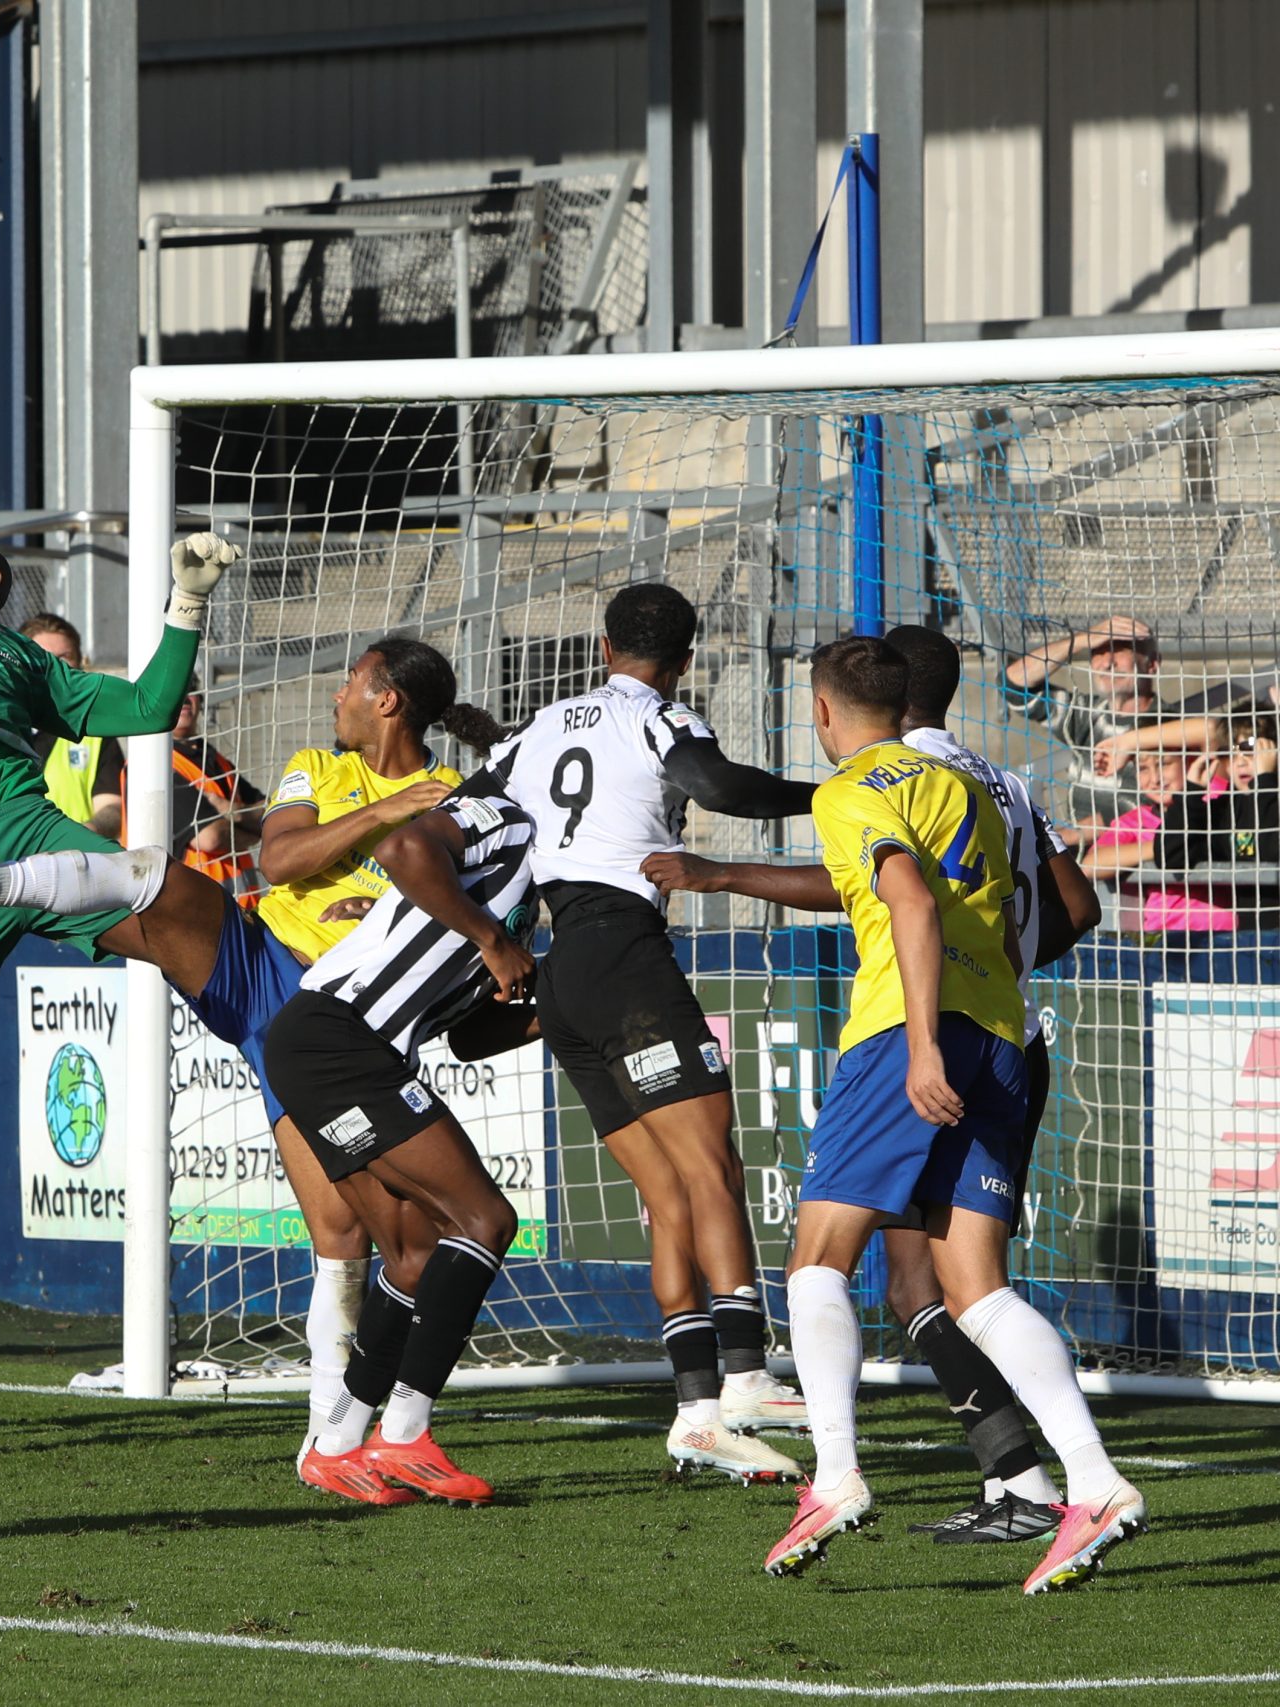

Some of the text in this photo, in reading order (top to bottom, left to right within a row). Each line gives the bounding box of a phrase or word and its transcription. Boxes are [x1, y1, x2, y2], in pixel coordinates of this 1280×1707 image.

[563, 706, 602, 734] REID
[550, 746, 594, 849] 9
[30, 986, 117, 1045] Earthly
[30, 1173, 126, 1220] Matters
[208, 1215, 261, 1239] DESIGN
[1209, 1220, 1252, 1245] Trade
